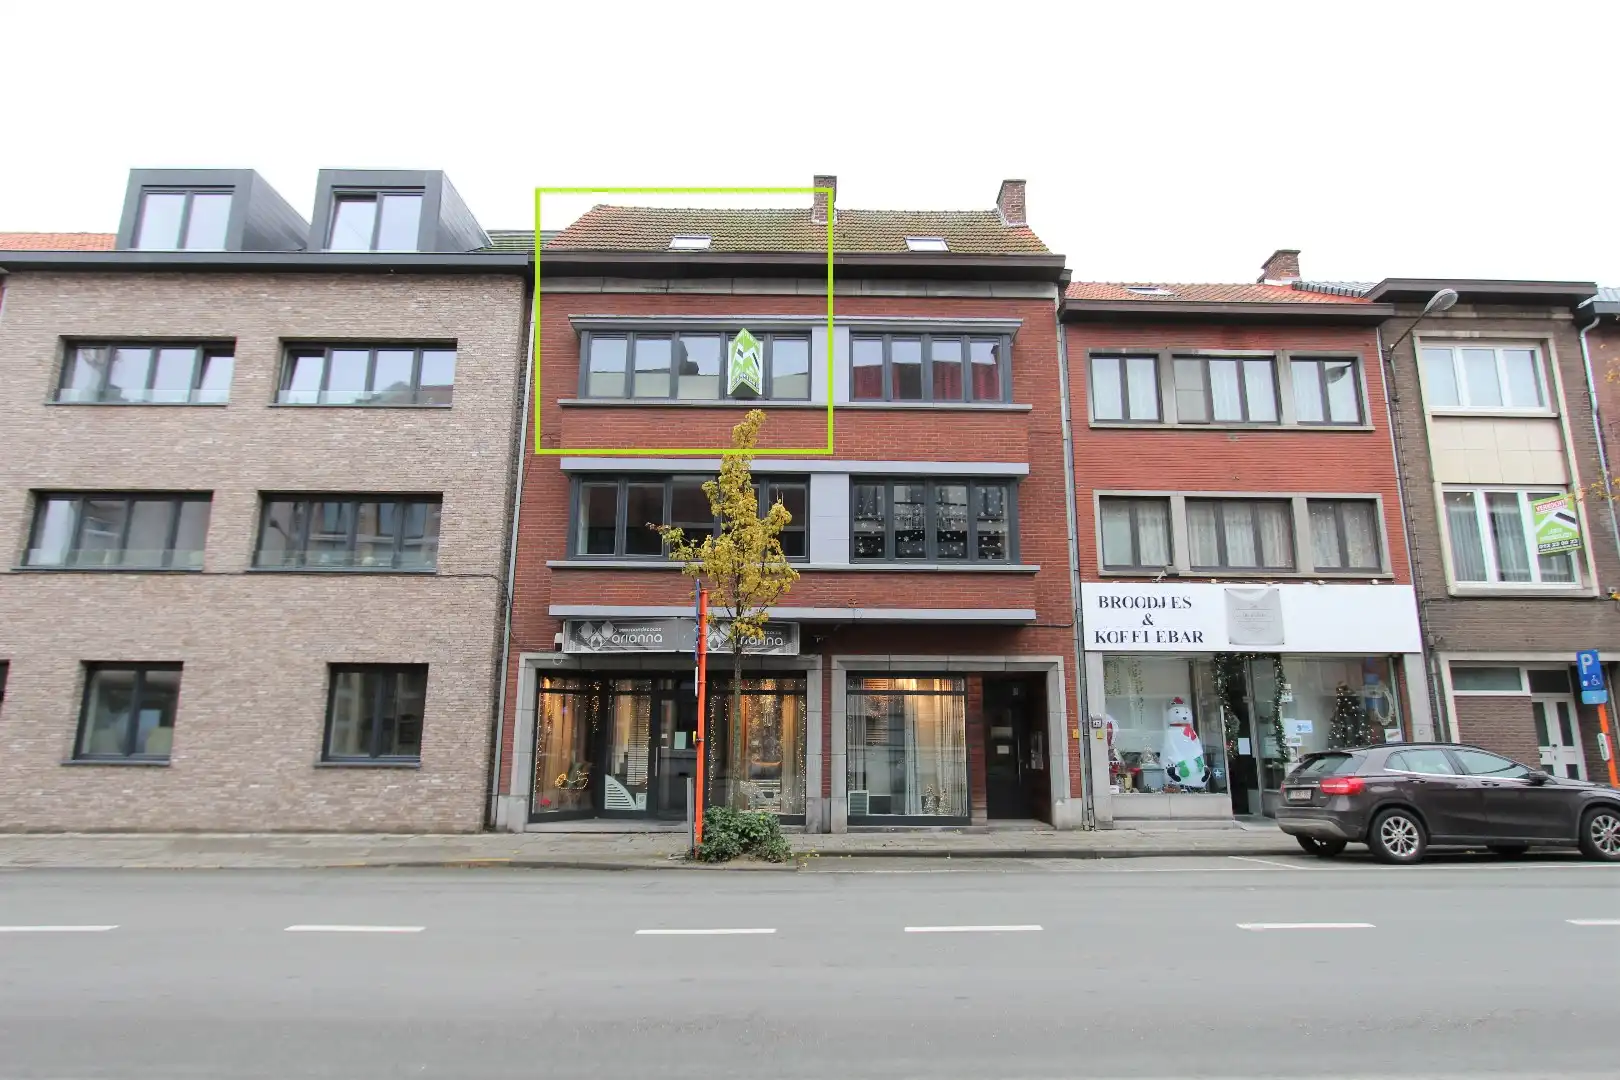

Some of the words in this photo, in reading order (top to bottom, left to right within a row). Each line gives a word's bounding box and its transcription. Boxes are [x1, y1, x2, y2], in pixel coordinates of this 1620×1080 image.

[1098, 595, 1192, 609] BROODJES
[1142, 612, 1154, 626] &
[612, 633, 663, 643] arianna
[1580, 653, 1593, 675] P
